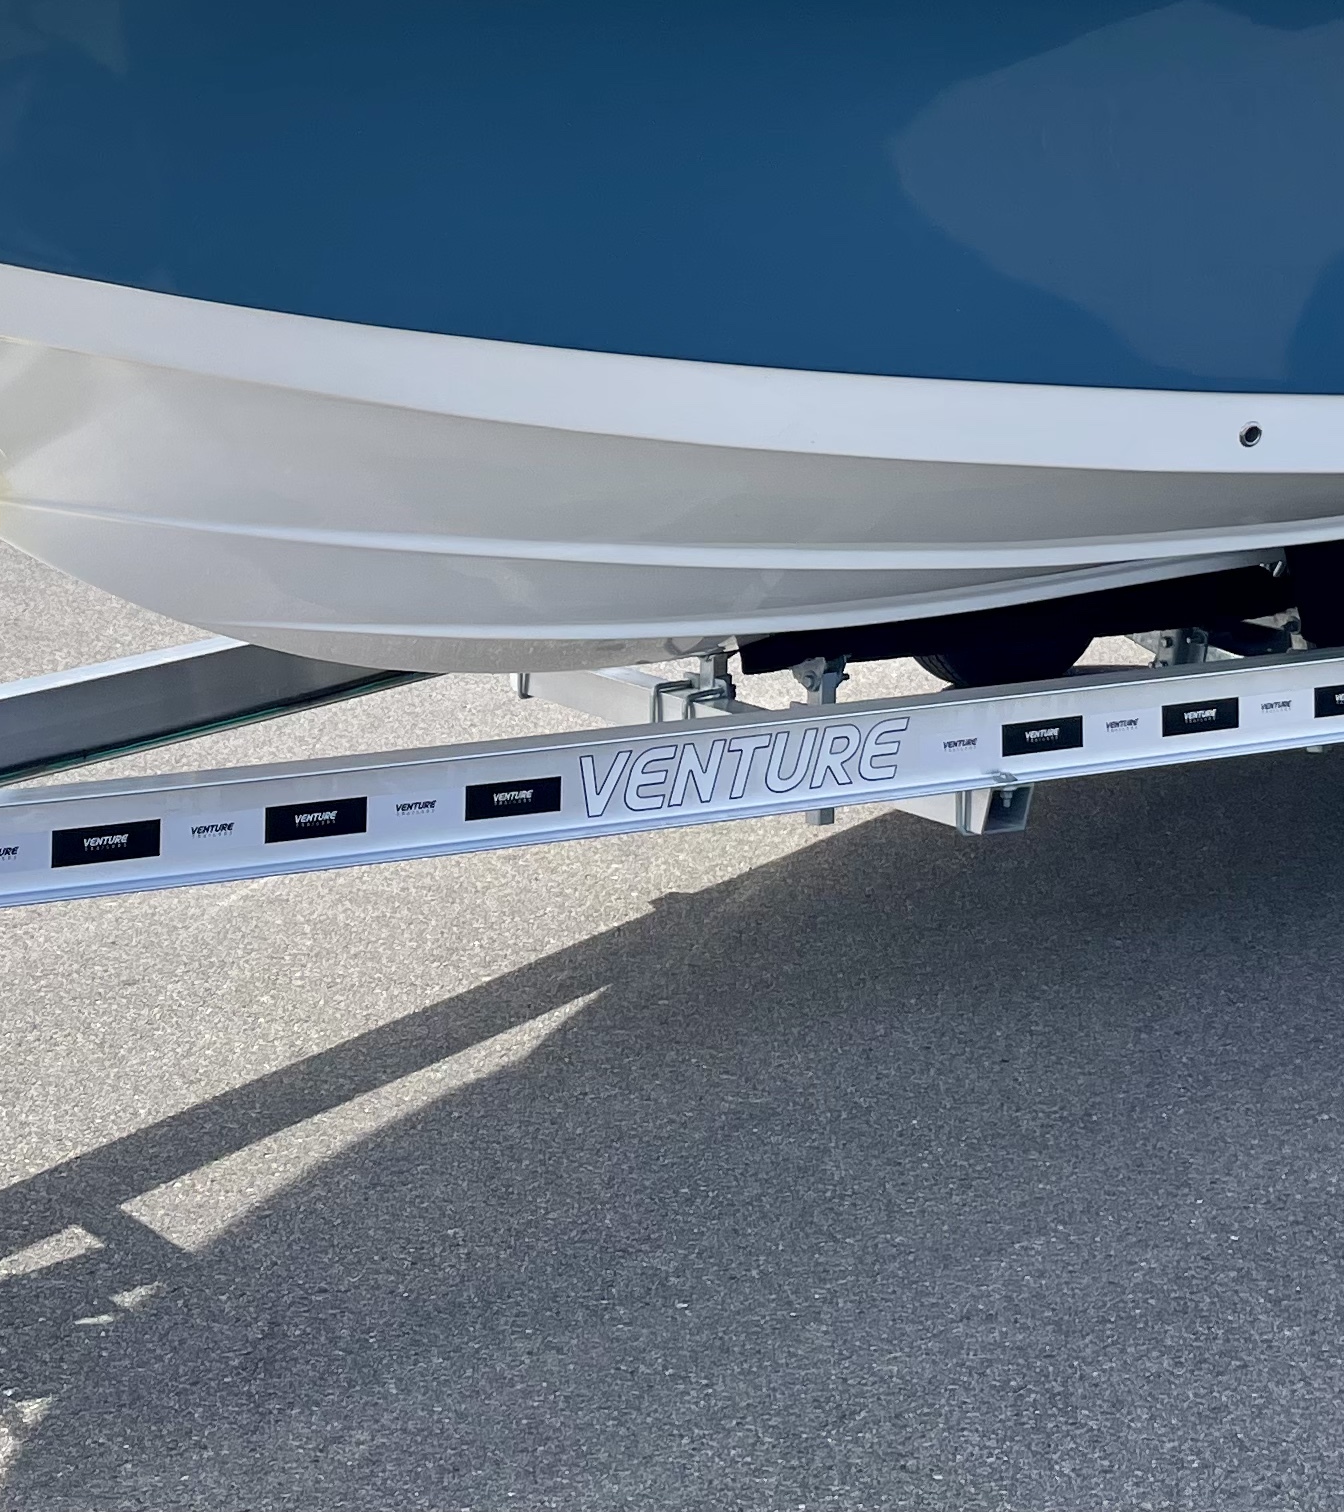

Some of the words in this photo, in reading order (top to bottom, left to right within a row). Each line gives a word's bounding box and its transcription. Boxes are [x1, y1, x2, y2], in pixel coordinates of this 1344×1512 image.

[578, 716, 911, 819] VENTURE
[493, 789, 534, 802] VENTURE
[395, 799, 437, 813] VENTURE
[294, 810, 338, 824] VENTURE
[191, 822, 235, 835] VENTURE
[83, 833, 129, 848] VENTURE
